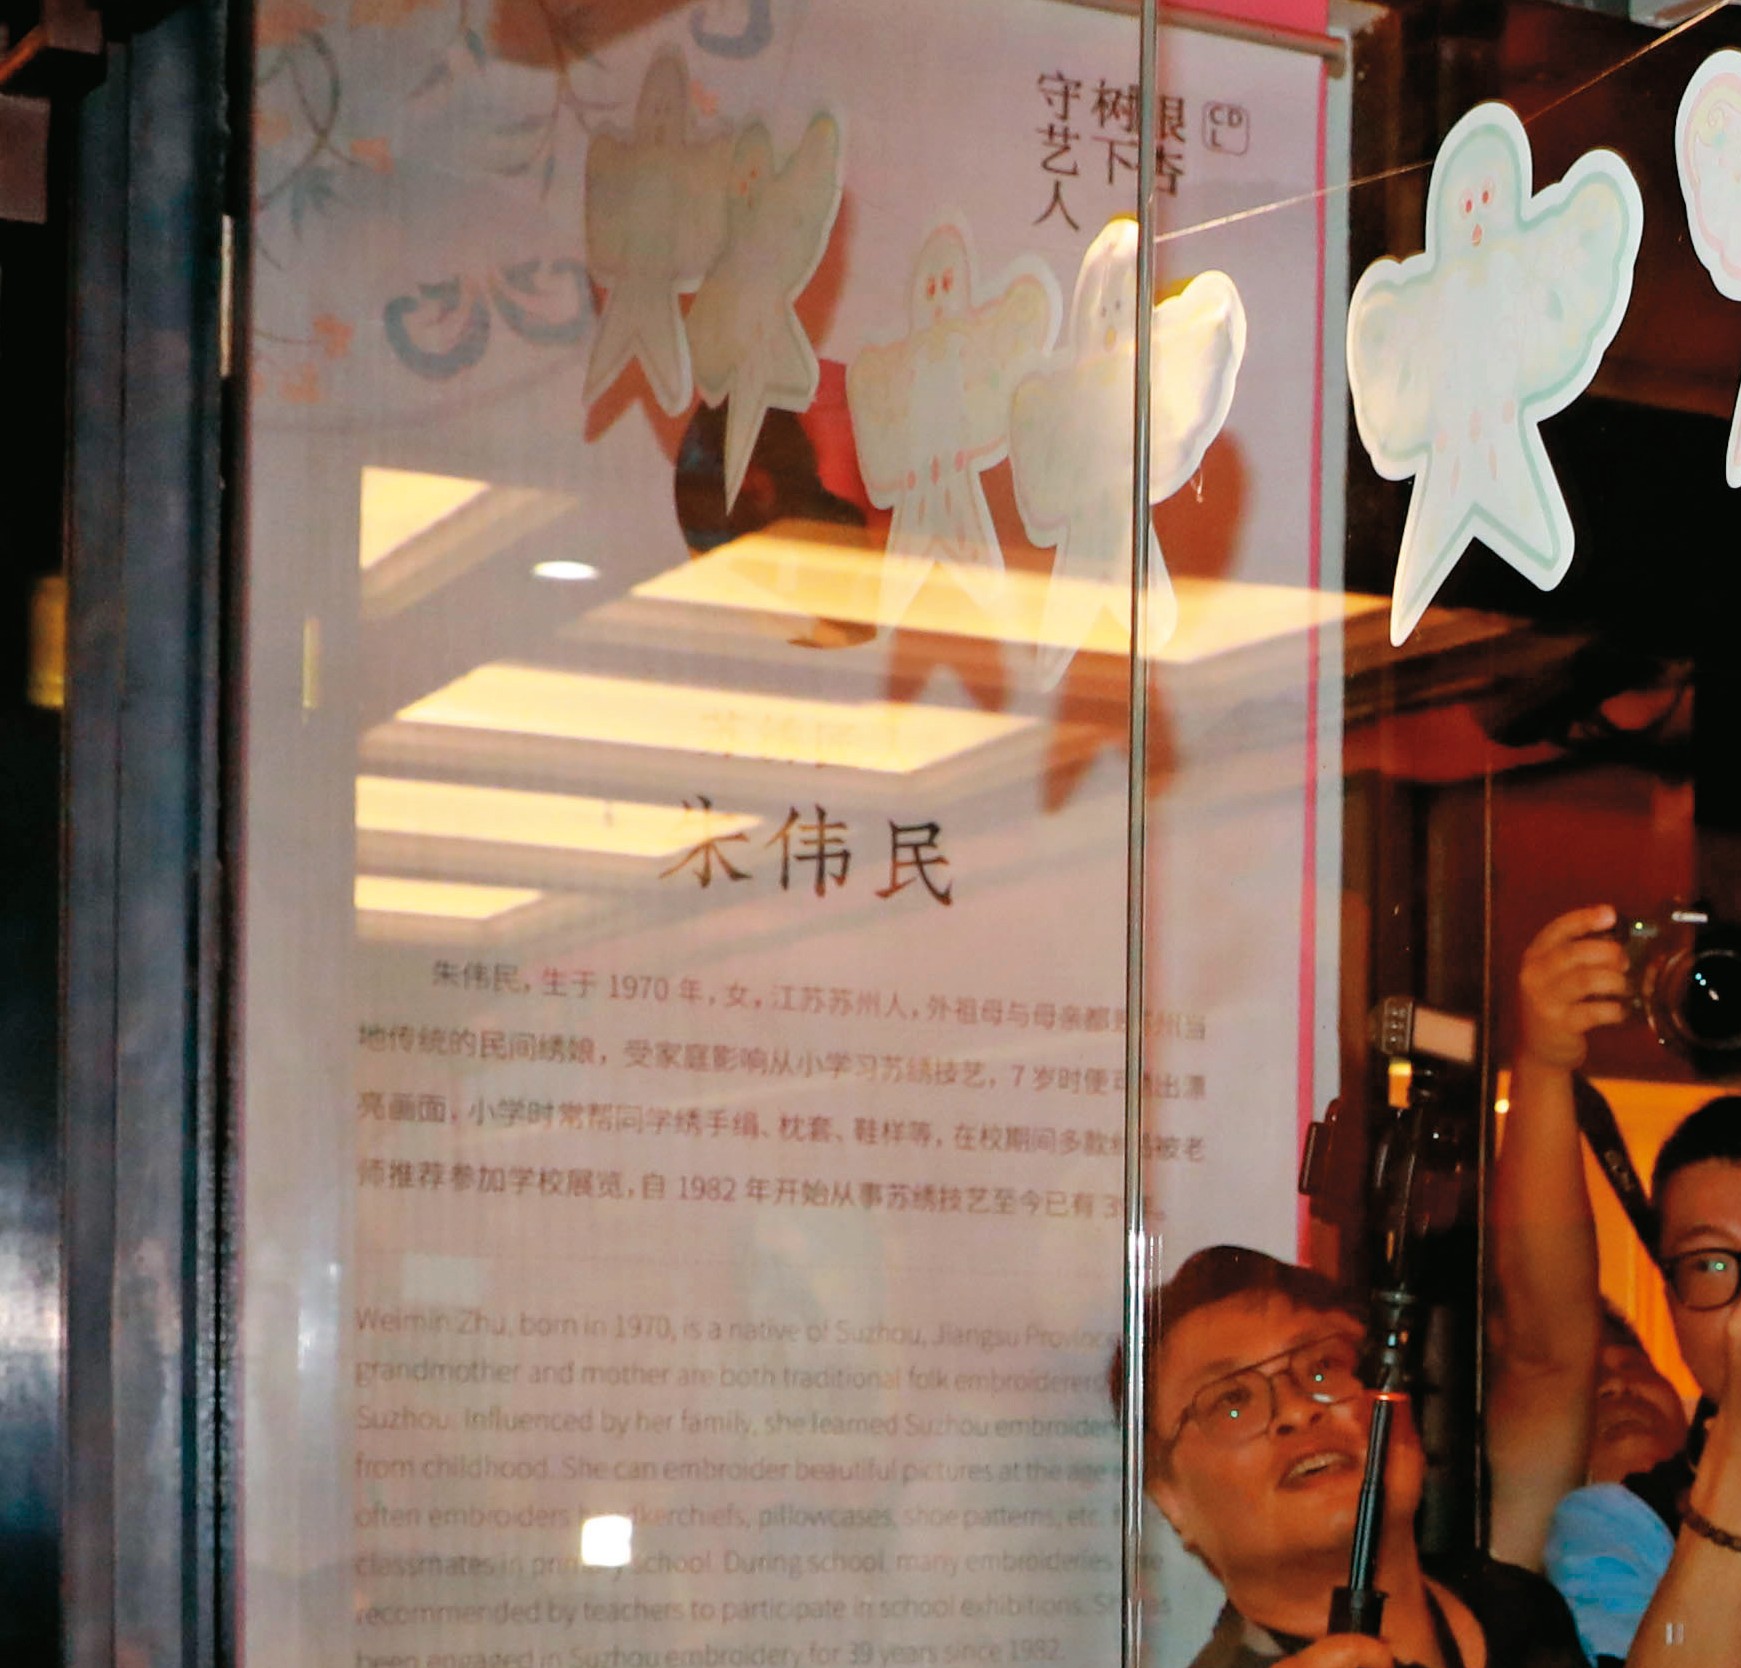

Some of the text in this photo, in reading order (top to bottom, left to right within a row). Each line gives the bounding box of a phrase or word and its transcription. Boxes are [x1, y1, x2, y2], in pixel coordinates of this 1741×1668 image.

[1034, 72, 1081, 233] 守艺人
[609, 974, 670, 1001] 1970
[679, 1173, 737, 1202] 1982
[614, 1312, 677, 1345] 1970,
[355, 1361, 522, 1388] grandmother
[527, 1361, 576, 1385] and
[581, 1362, 670, 1386] mother
[676, 1367, 715, 1387] are
[719, 1366, 777, 1388] both
[907, 1367, 949, 1389] folk
[600, 1410, 629, 1439] by
[635, 1410, 673, 1433] her
[764, 1414, 805, 1436] she
[811, 1413, 899, 1436] learned
[904, 1415, 989, 1438] Suzhou
[354, 1452, 416, 1480] from
[561, 1455, 609, 1480] She
[613, 1459, 657, 1481] can
[662, 1459, 788, 1483] embroider
[902, 1459, 994, 1487] pictures
[353, 1500, 421, 1528] often
[902, 1505, 961, 1528] shoe
[353, 1553, 496, 1578] classmates
[895, 1555, 958, 1581] many
[547, 1599, 577, 1629] by
[583, 1599, 687, 1623] teachers
[690, 1600, 716, 1622] to
[720, 1596, 847, 1625] participate
[879, 1596, 955, 1621] school
[809, 1643, 840, 1666] for
[846, 1639, 875, 1666] 39
[943, 1640, 1004, 1664] since
